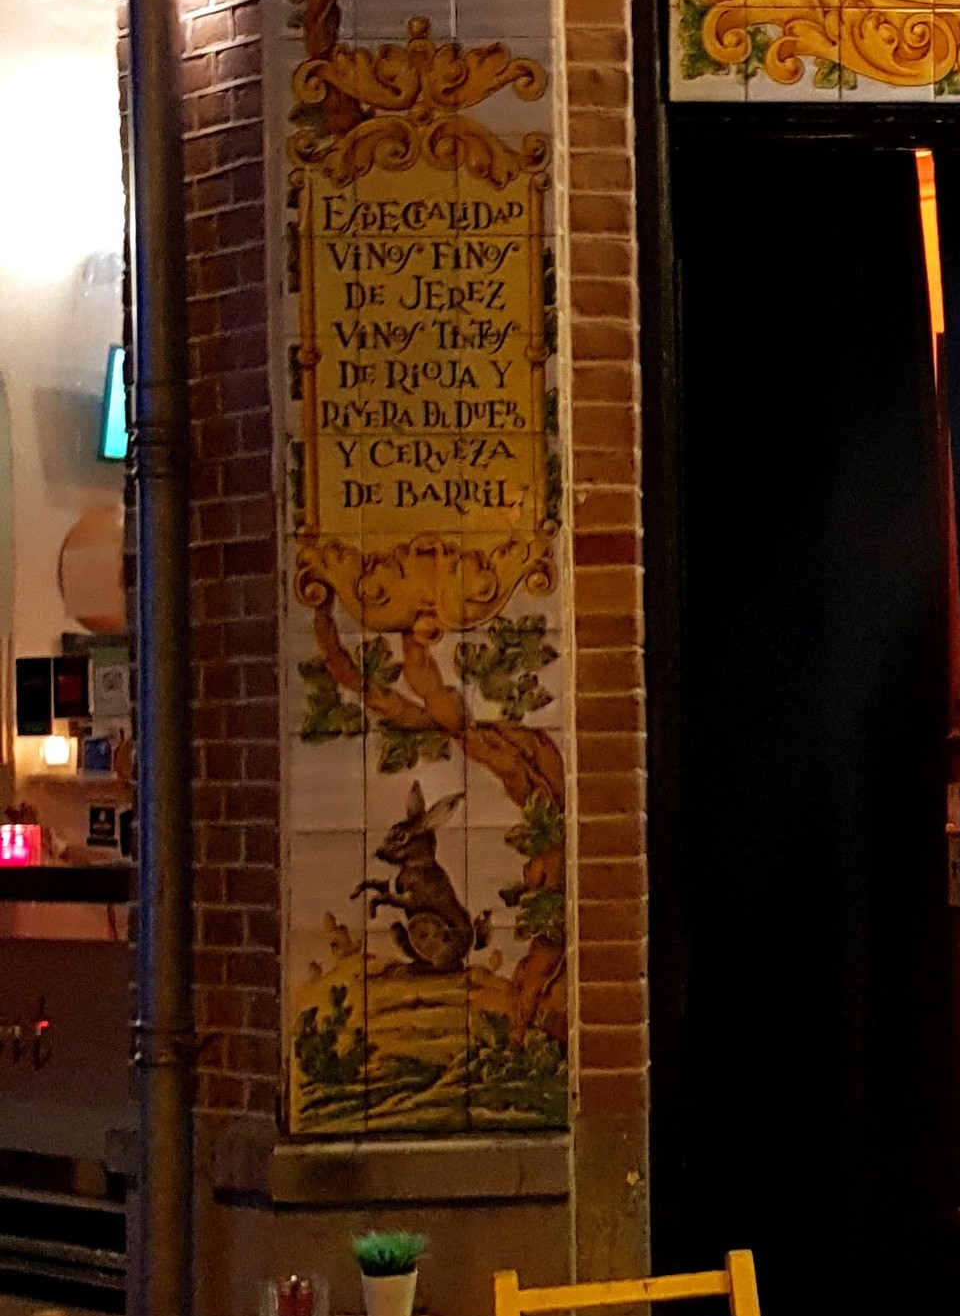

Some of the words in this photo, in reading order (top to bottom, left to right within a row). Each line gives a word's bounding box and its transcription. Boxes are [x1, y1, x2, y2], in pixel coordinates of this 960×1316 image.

[323, 193, 524, 233] ESPECIALIDAD
[326, 241, 424, 274] VINOS
[431, 241, 520, 274] FINOS
[345, 283, 385, 309] DE
[400, 275, 506, 314] JEREZ
[332, 320, 424, 353] VINOS
[338, 360, 376, 389] DE
[385, 360, 477, 394] RIOJA
[489, 361, 513, 388] Y
[321, 400, 414, 431] RIVERA
[454, 400, 526, 429] DUERO
[337, 441, 357, 468] Y
[370, 437, 517, 473] CERVEZA
[342, 480, 383, 508] DE
